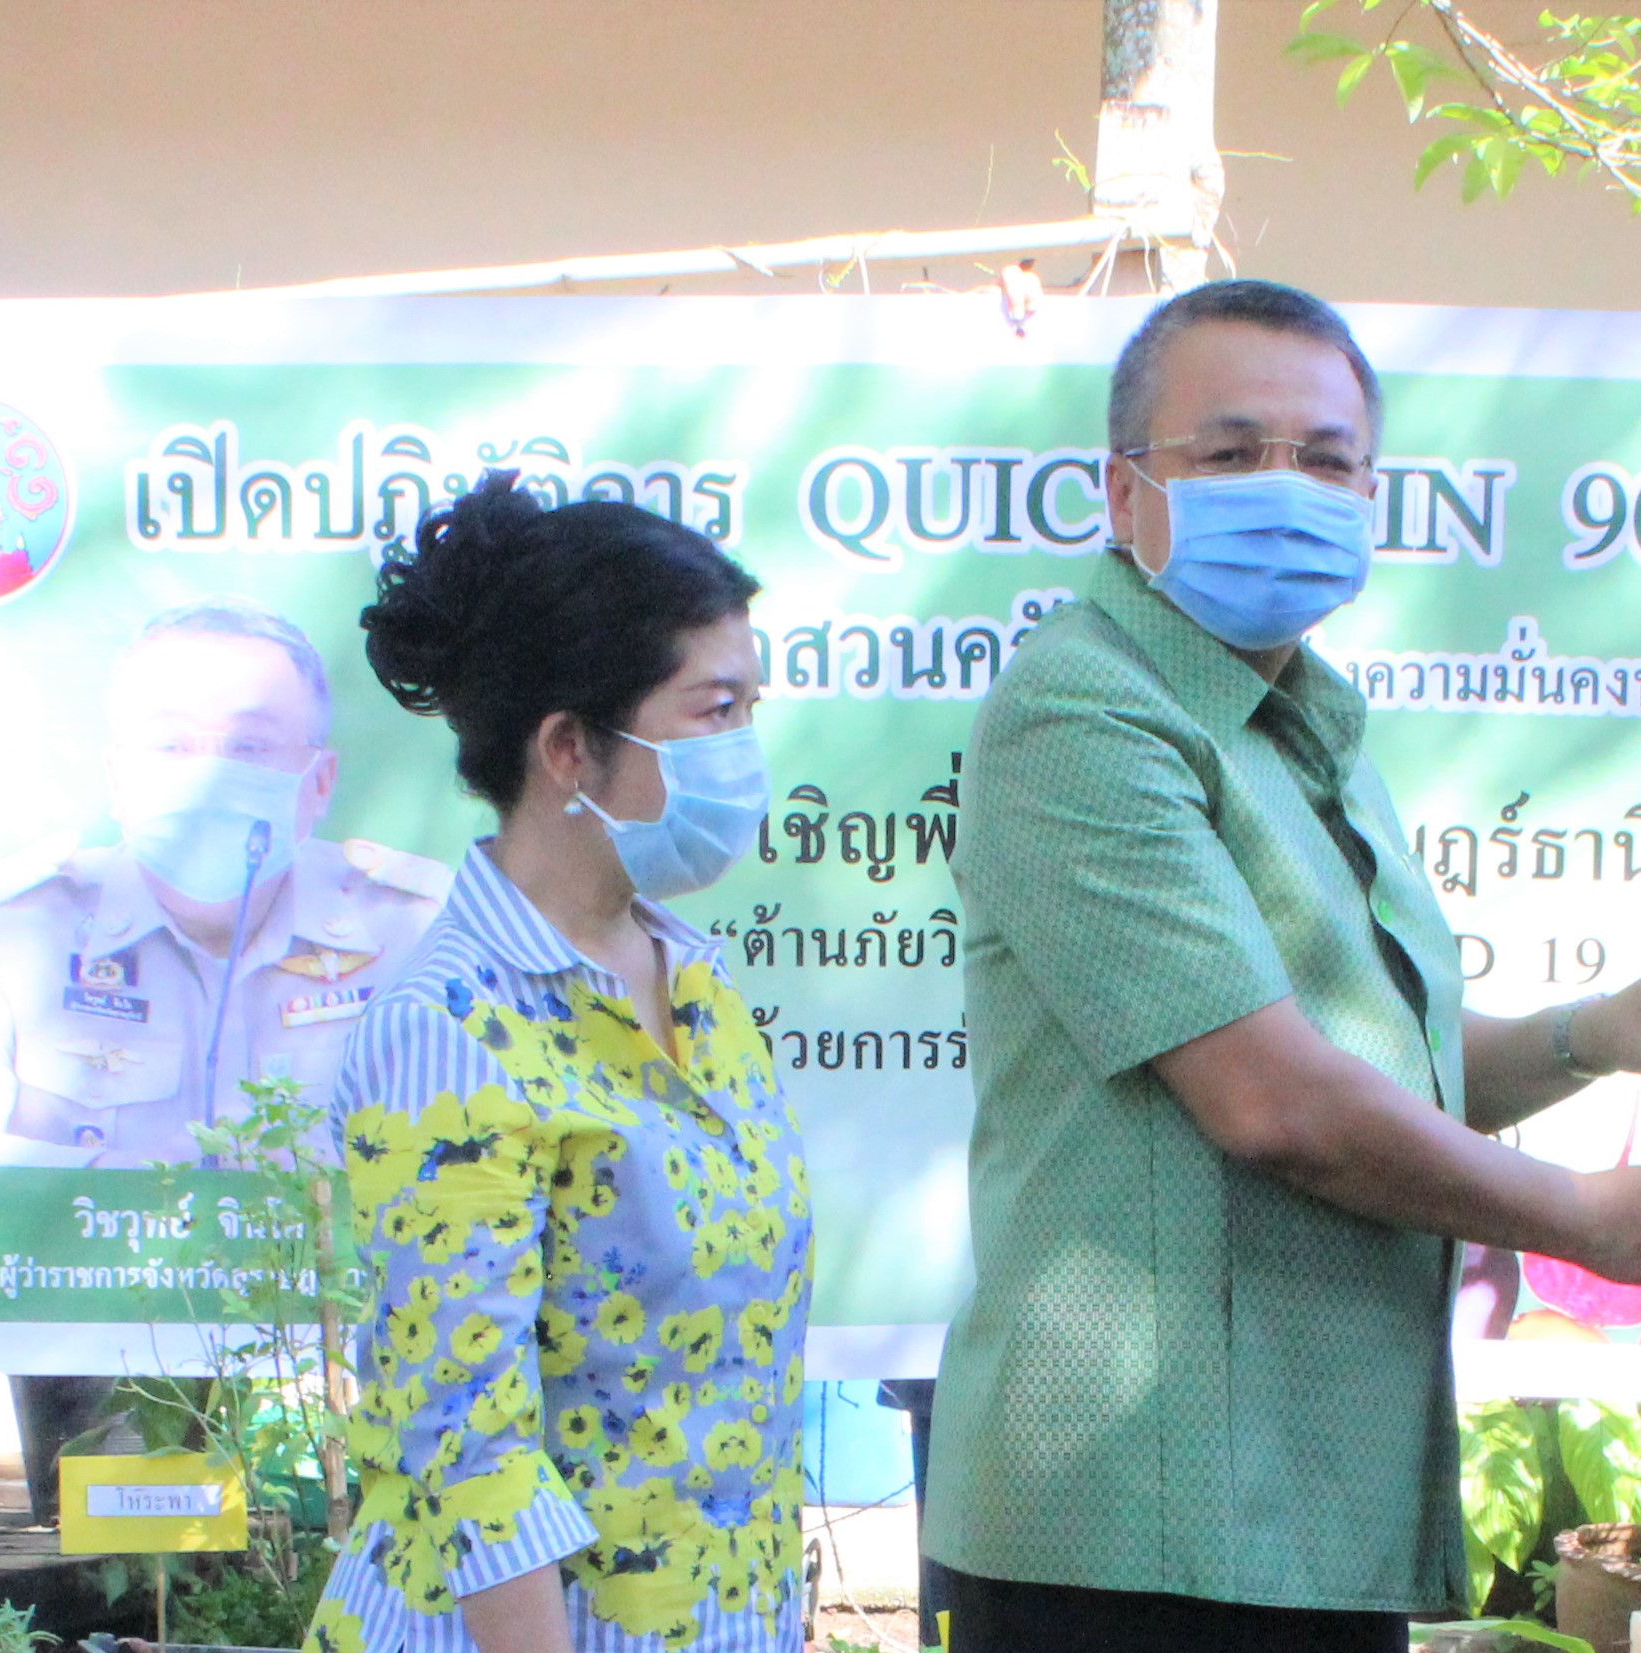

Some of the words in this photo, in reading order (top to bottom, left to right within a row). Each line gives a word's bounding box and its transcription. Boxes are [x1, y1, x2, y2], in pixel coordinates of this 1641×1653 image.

[809, 455, 1115, 562] QUIC
[1372, 465, 1505, 557] IN
[1541, 936, 1608, 985] 19
